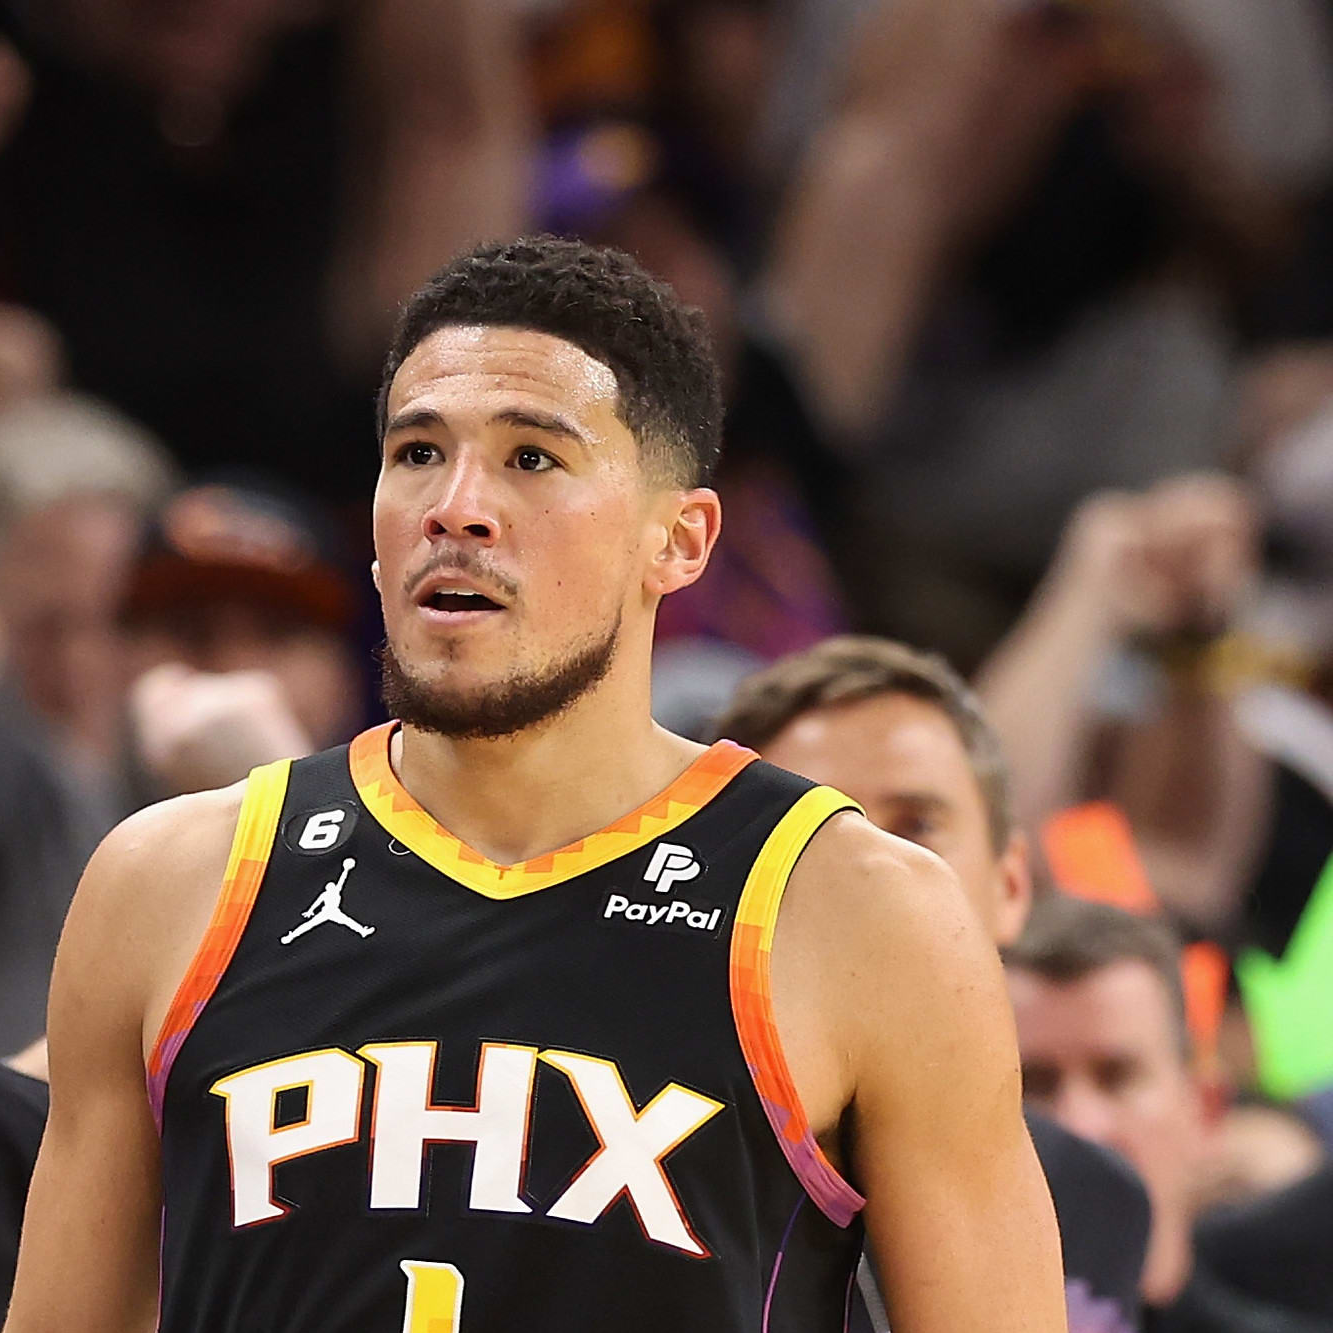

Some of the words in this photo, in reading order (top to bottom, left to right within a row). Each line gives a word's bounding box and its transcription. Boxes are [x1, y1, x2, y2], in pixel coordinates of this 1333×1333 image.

[298, 809, 345, 849] 6
[603, 894, 722, 931] PayPal
[208, 1040, 726, 1260] PHX
